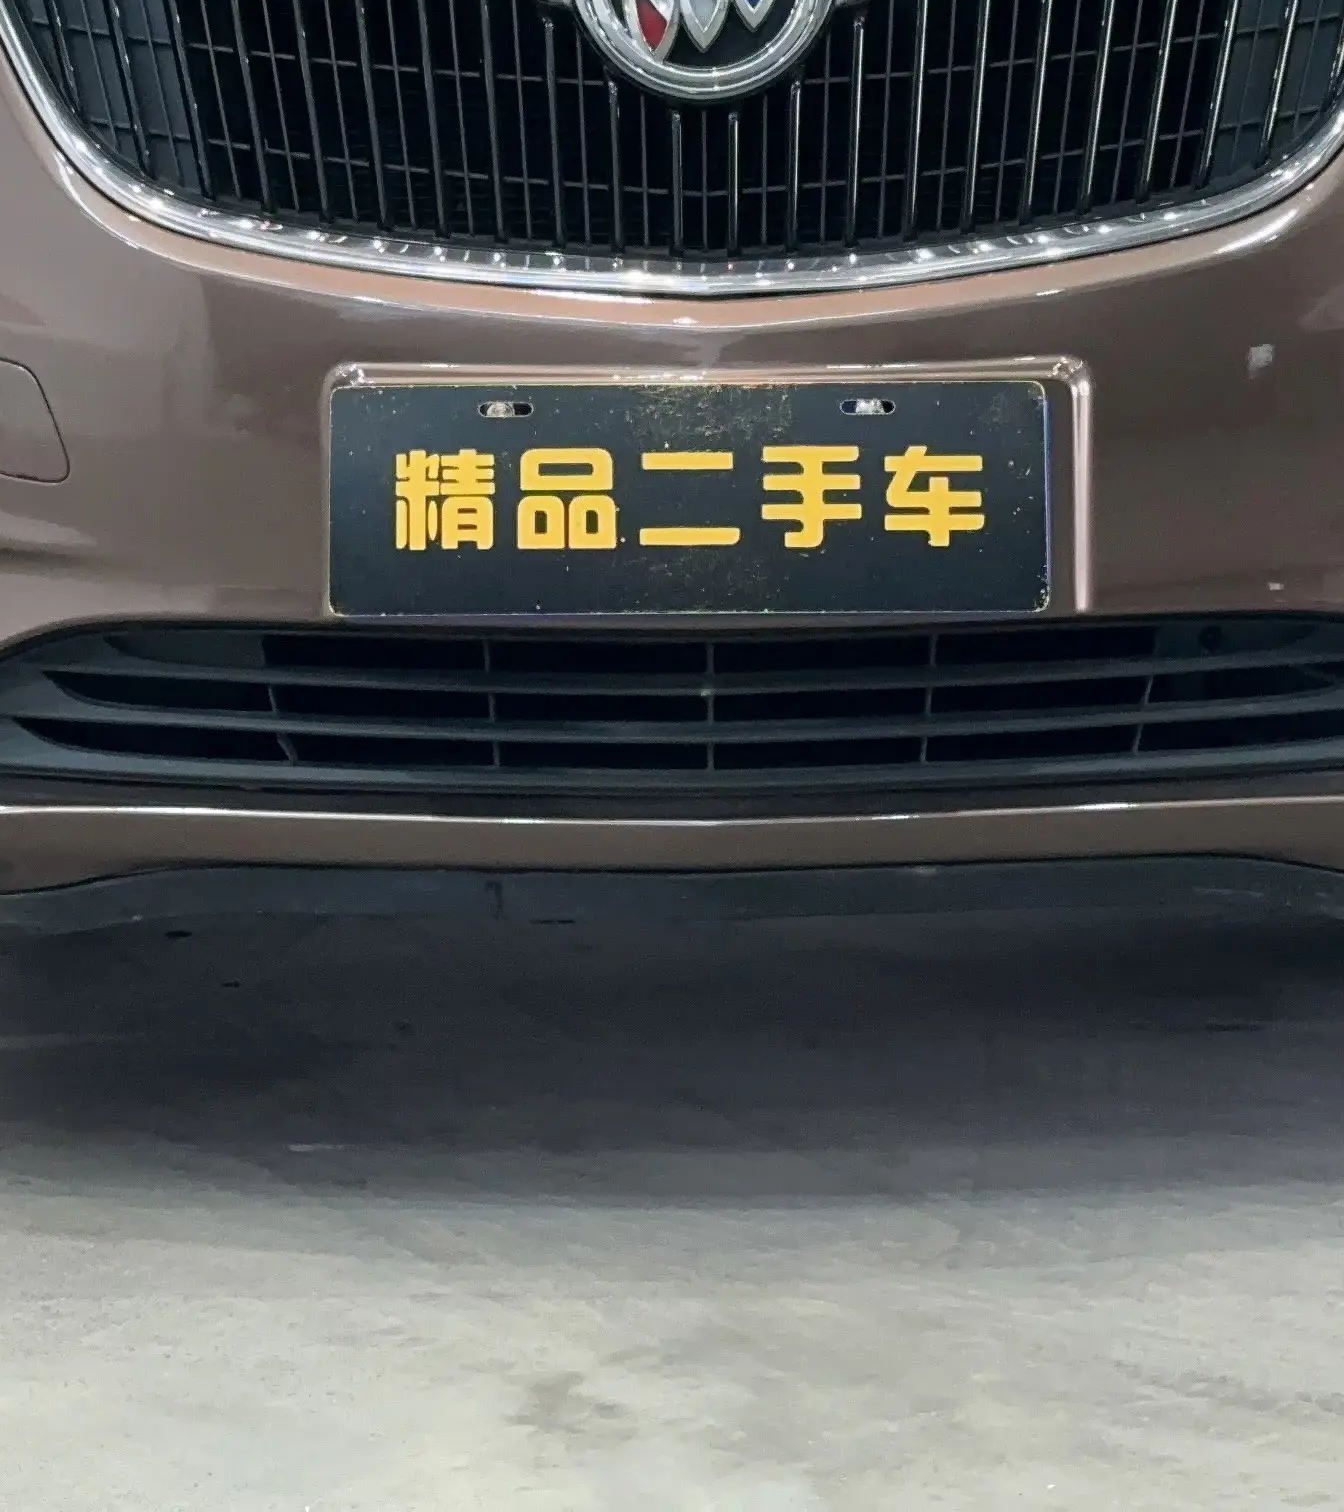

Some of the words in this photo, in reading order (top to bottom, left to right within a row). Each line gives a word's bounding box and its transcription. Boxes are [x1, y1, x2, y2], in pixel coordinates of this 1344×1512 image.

[395, 445, 985, 550] 精品二手车
